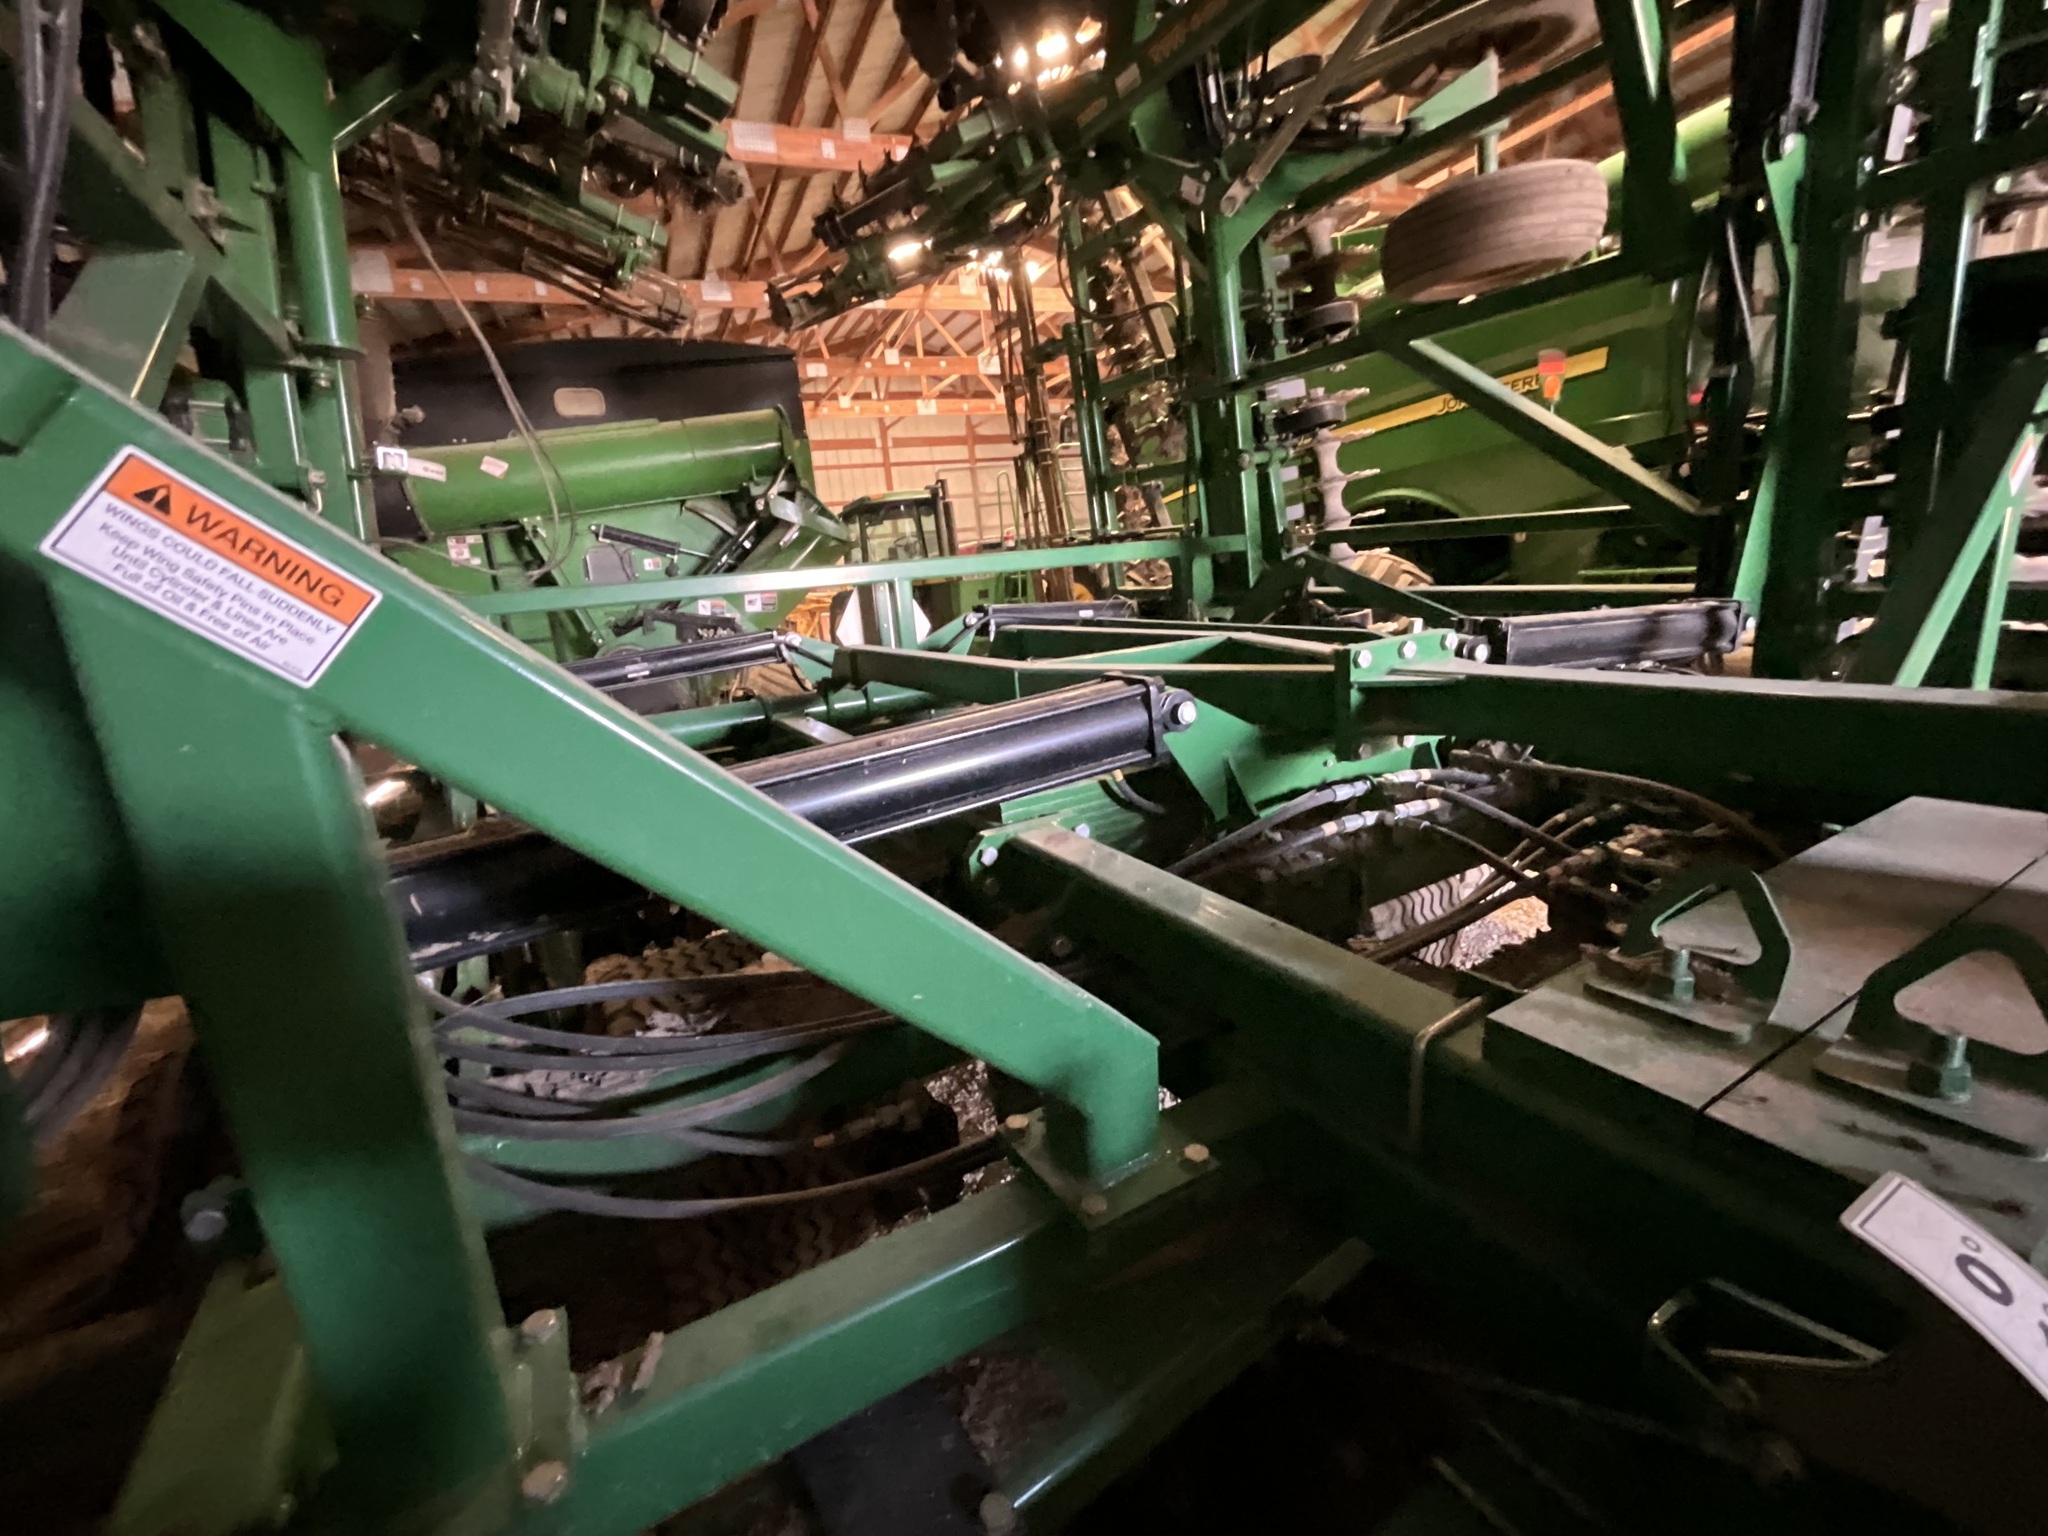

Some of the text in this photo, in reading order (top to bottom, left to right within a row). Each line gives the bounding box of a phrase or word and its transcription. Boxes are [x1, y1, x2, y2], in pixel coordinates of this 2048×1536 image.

[99, 522, 141, 551] Keep
[141, 546, 182, 573] Wing
[182, 568, 229, 598] Safety
[231, 594, 261, 615] Pins
[279, 620, 316, 644] Place
[105, 503, 336, 635] WINGS COULD FALL SUDDENLY
[113, 546, 148, 569] Until
[148, 566, 210, 605] Cylinder
[226, 607, 263, 631] Lines
[265, 627, 289, 645] Are
[187, 505, 344, 606] WARNING
[113, 563, 142, 583] Full
[144, 579, 162, 594] of
[162, 589, 184, 606] Oil
[199, 609, 233, 632] Free
[233, 627, 250, 641] of
[252, 636, 271, 651] Air
